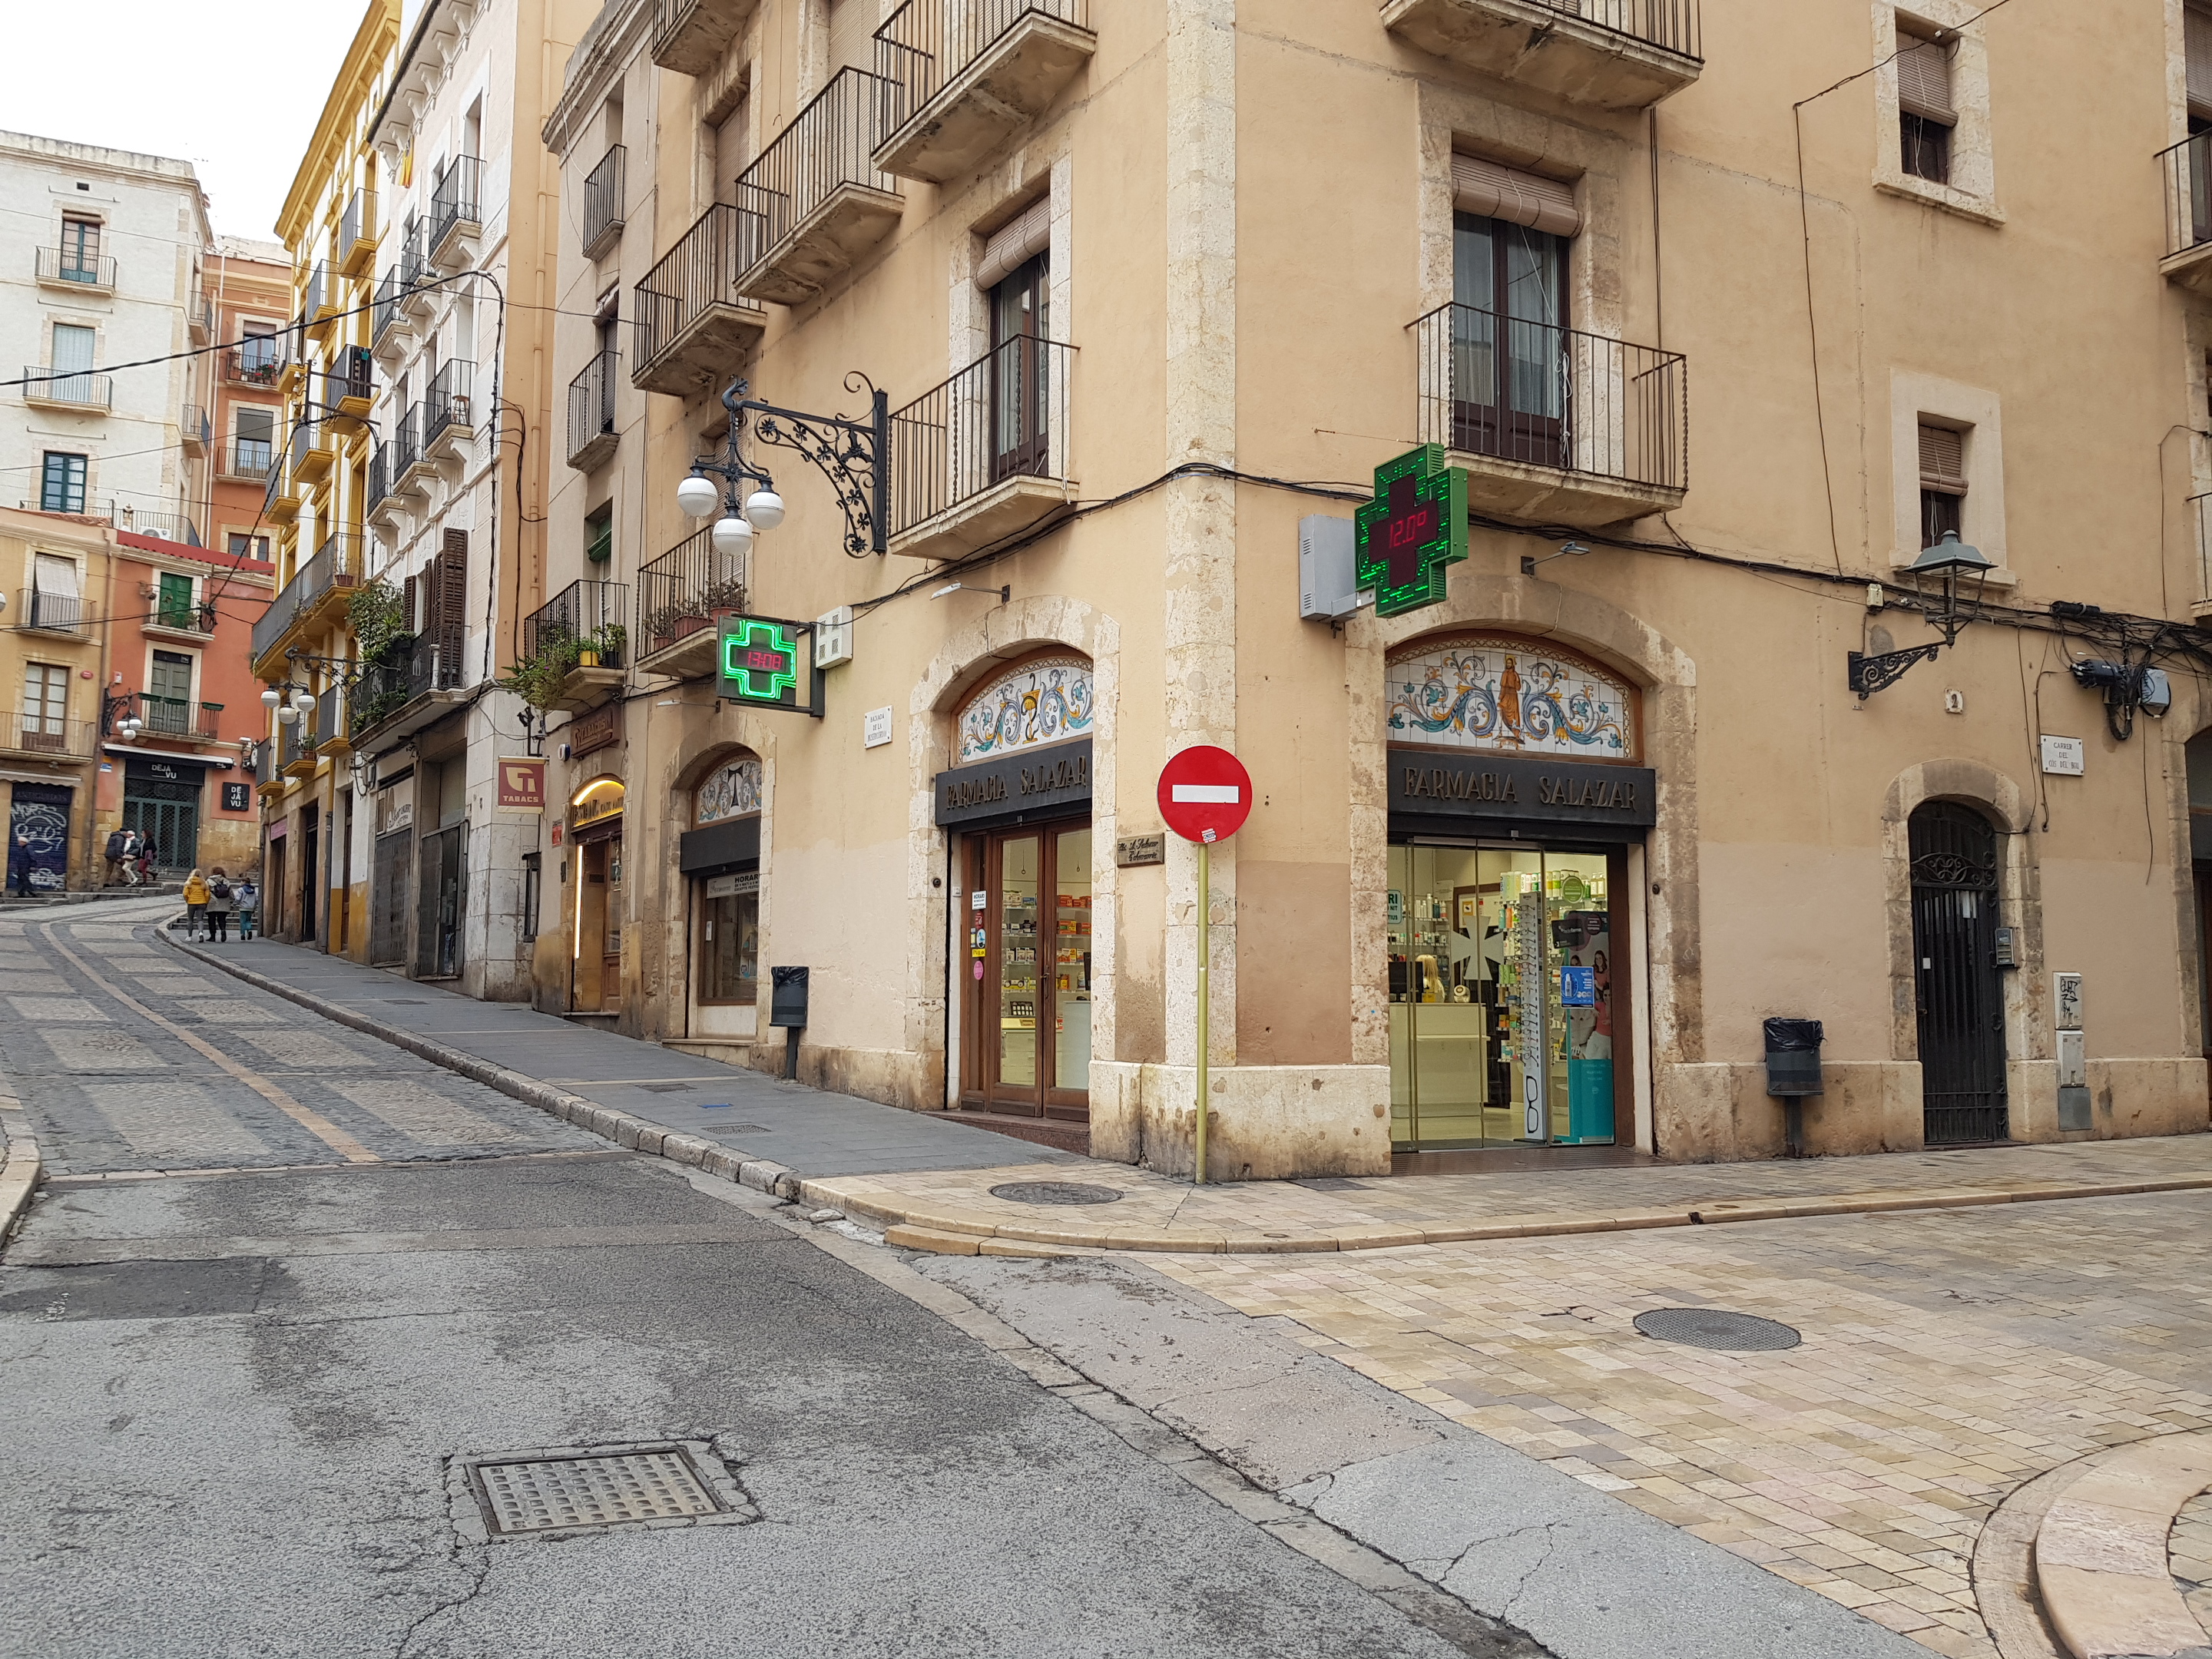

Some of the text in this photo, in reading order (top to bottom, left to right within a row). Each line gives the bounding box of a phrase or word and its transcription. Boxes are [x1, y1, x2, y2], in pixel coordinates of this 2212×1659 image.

[748, 651, 783, 670] 13:08
[1951, 694, 1958, 708] 2
[946, 755, 1087, 810] FARMACIA SALAZAR
[1403, 767, 1637, 813] FARMACIA SALAZAR
[734, 874, 759, 883] HORAR
[1388, 893, 1398, 904] RI
